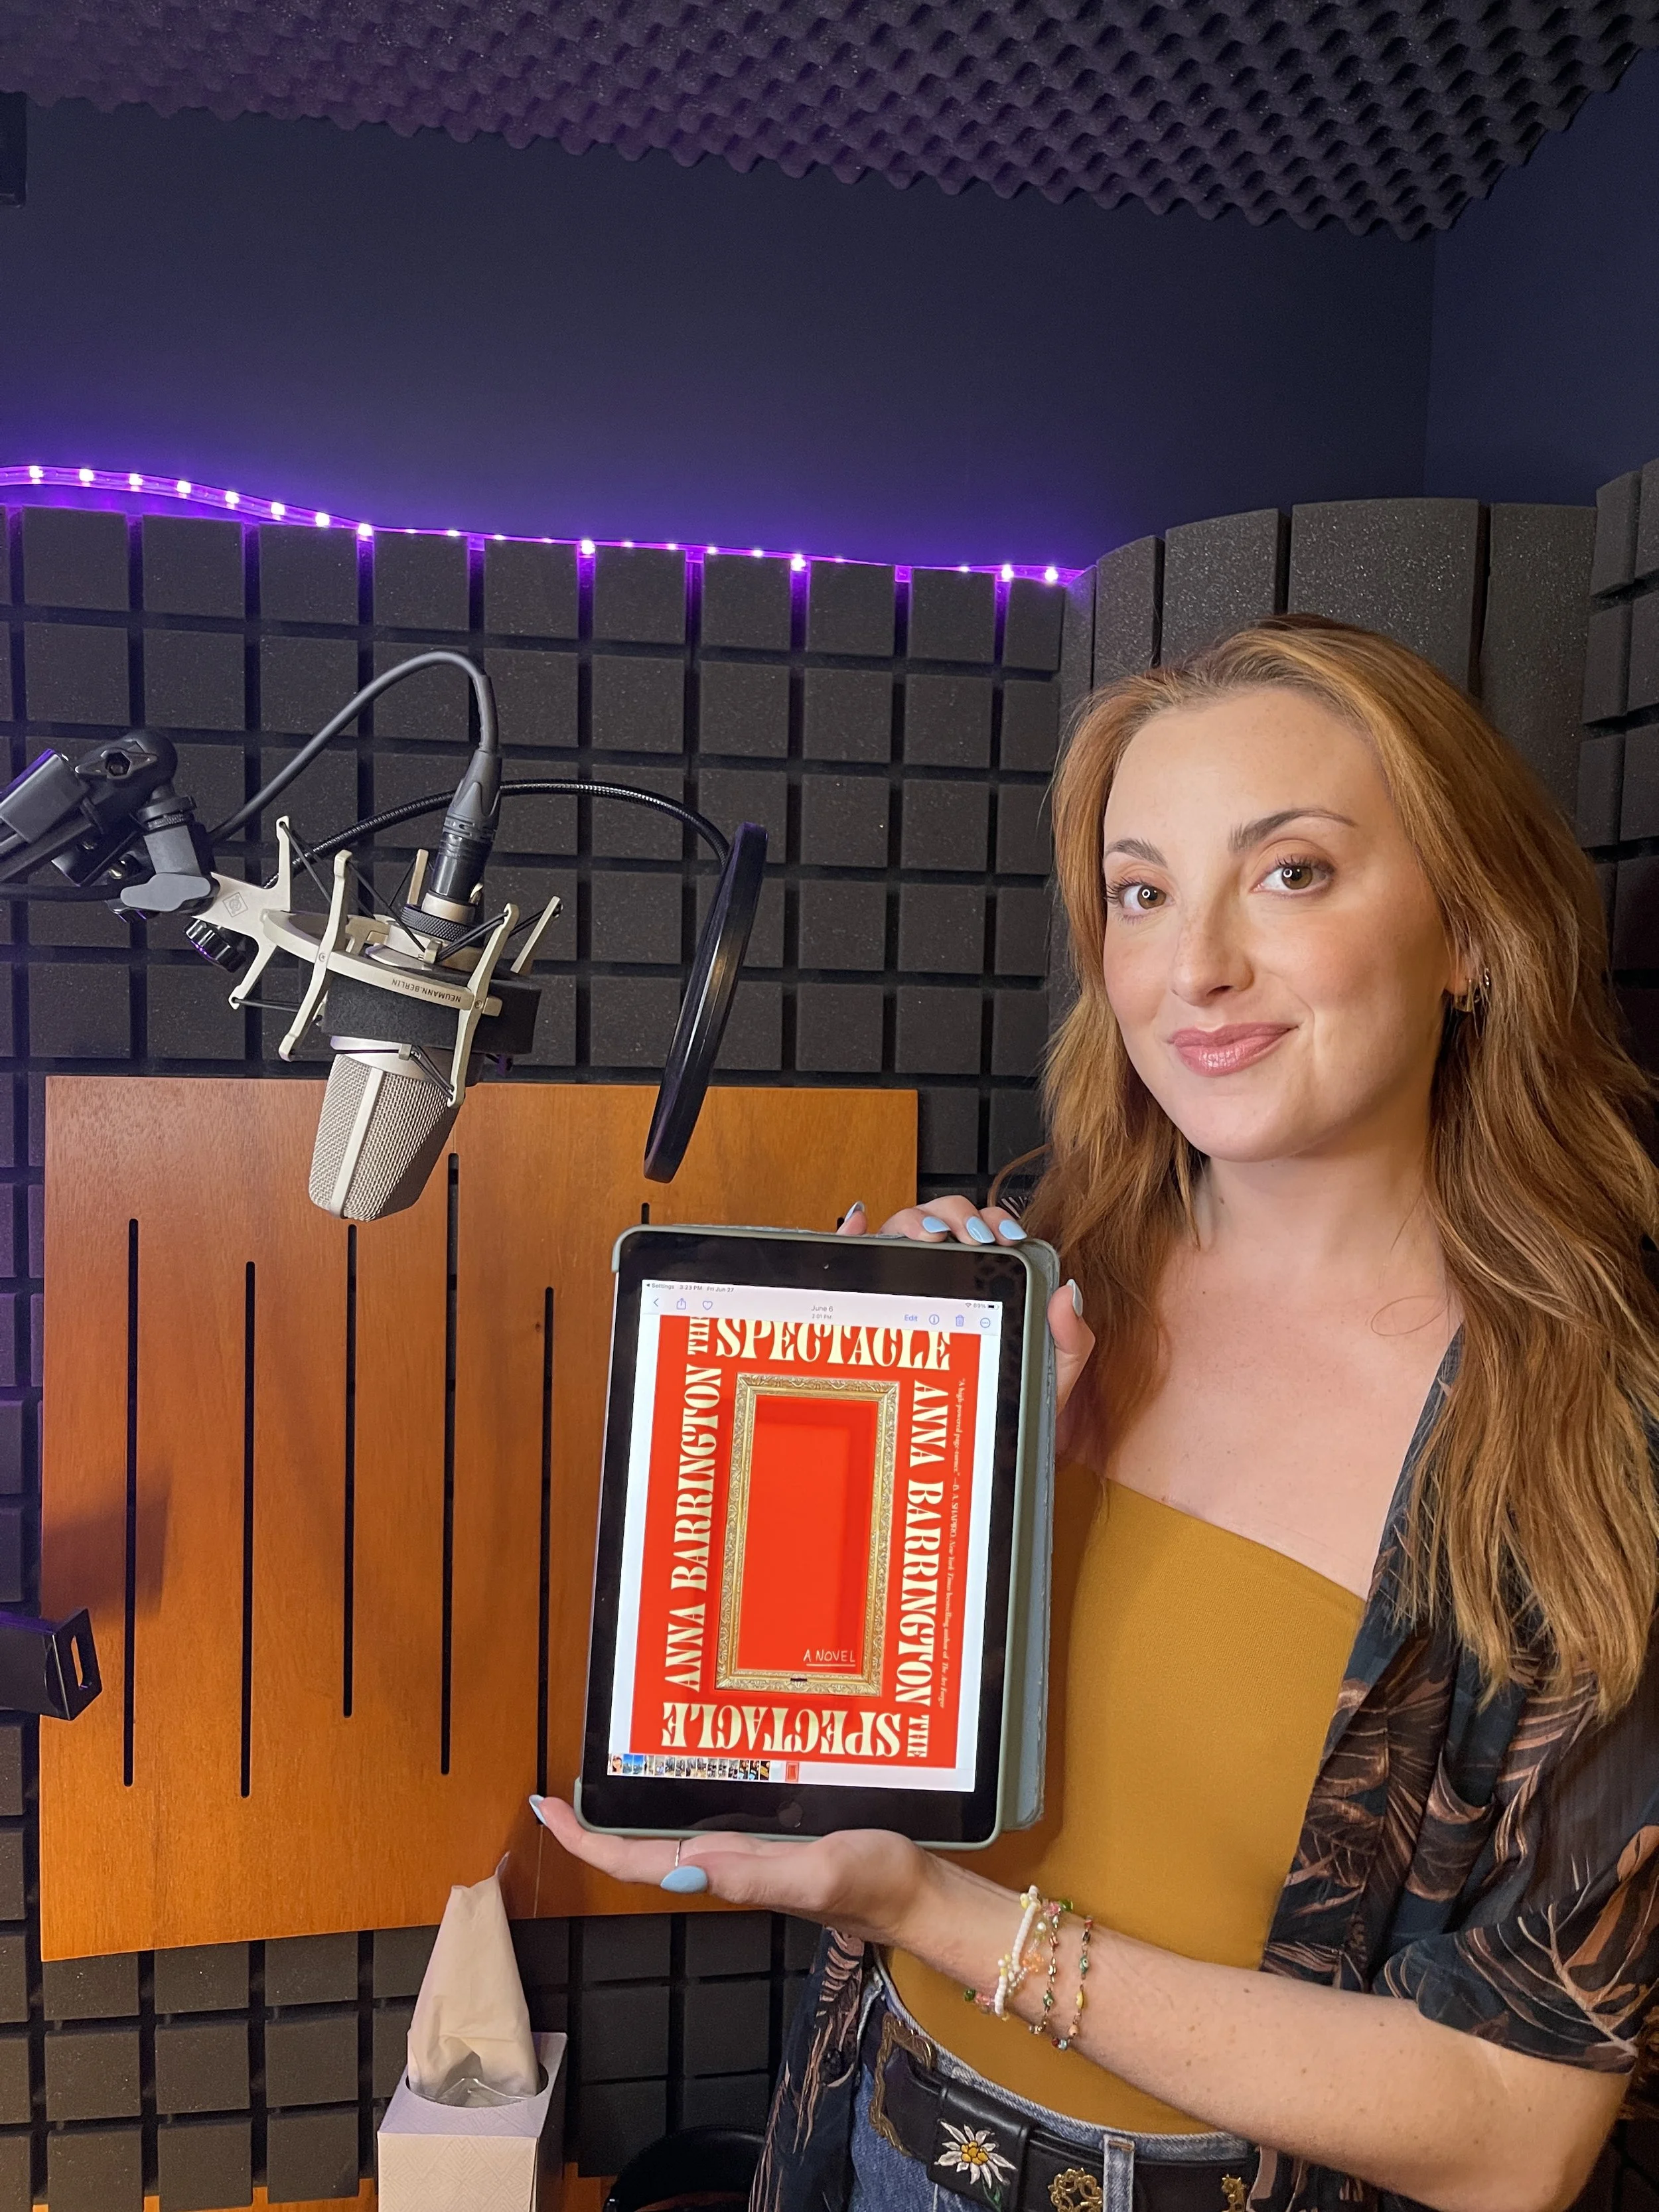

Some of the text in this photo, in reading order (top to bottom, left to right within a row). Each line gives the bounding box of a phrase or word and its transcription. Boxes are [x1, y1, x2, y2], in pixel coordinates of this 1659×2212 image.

[392, 978, 462, 1003] NEUMANN.BERLIN
[715, 1318, 951, 1371] SPECTACLE
[955, 1387, 966, 1434] high-powered
[664, 1363, 722, 1693] ANNA BARRINGTON
[660, 1379, 949, 1758] ANNA BARRINGTON THE SPECTACLE
[942, 1592, 953, 1627] bestselling
[803, 1649, 855, 1662] A NOVEL
[937, 1687, 947, 1709] Forger
